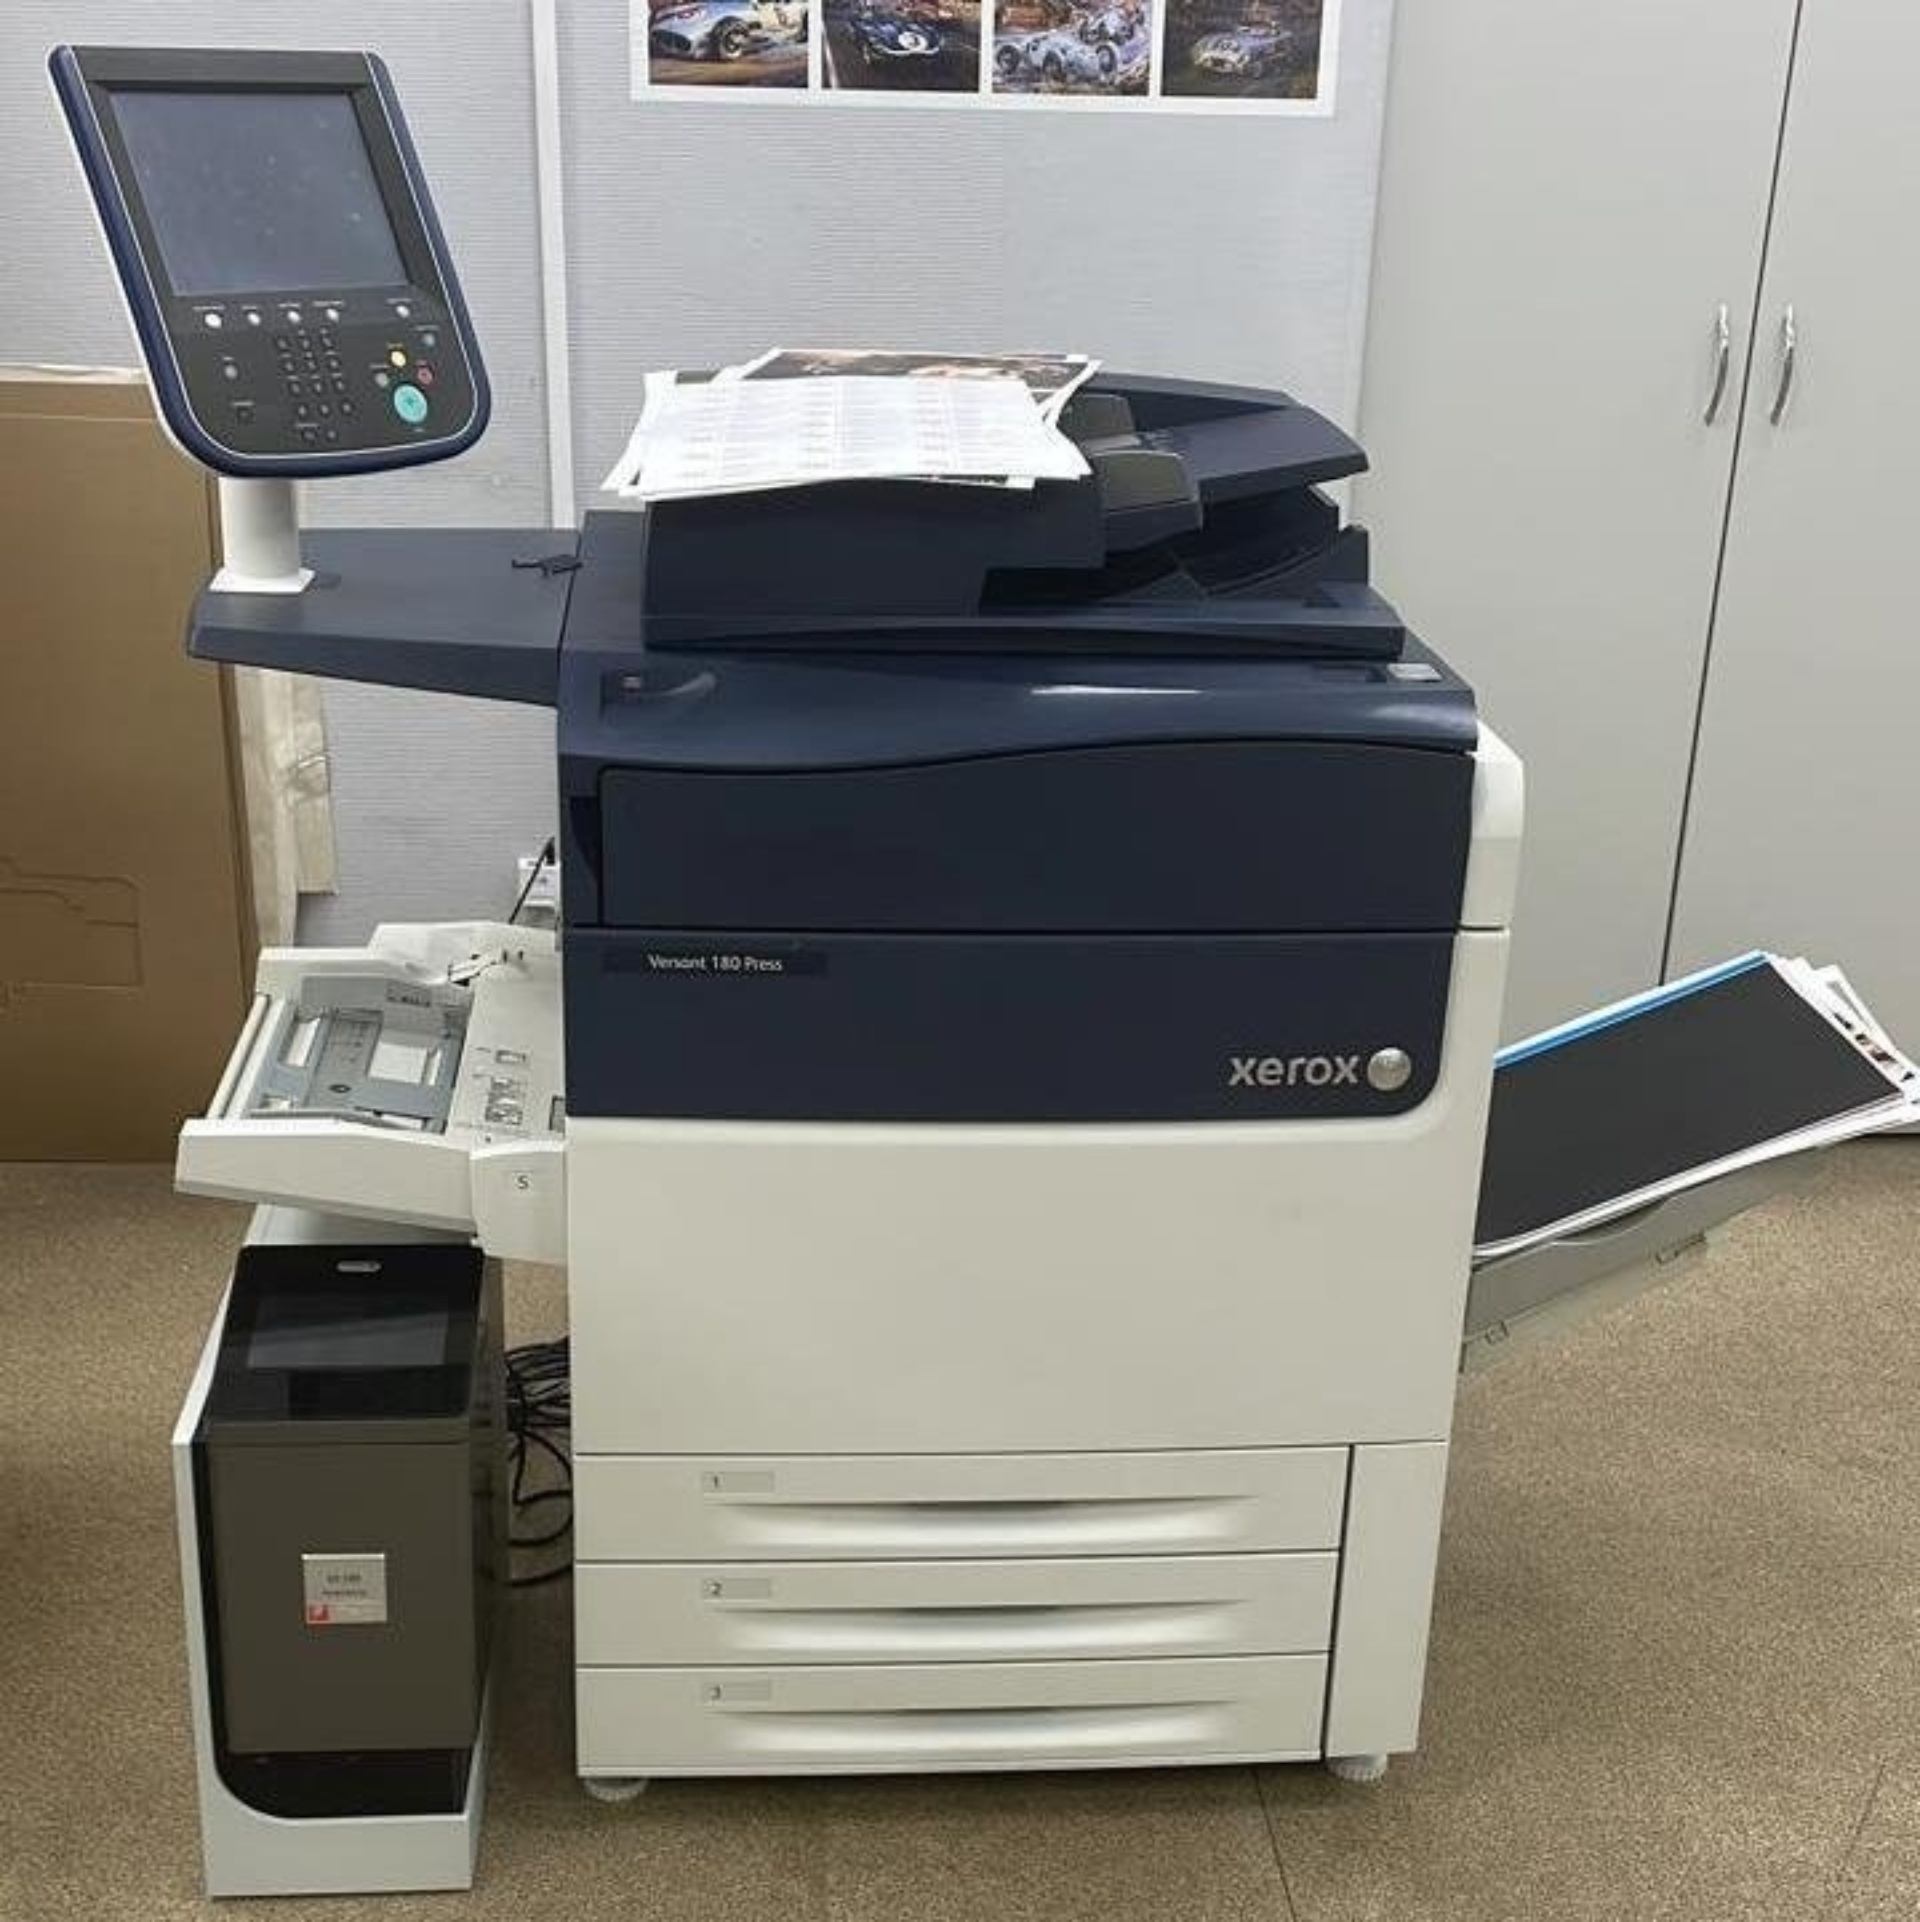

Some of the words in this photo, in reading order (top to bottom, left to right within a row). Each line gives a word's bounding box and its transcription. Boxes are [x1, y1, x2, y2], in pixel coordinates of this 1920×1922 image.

[648, 954, 705, 969] Versant
[711, 955, 741, 971] 180
[743, 956, 782, 972] Press
[1228, 1055, 1361, 1086] xerox
[710, 1583, 721, 1597] 2
